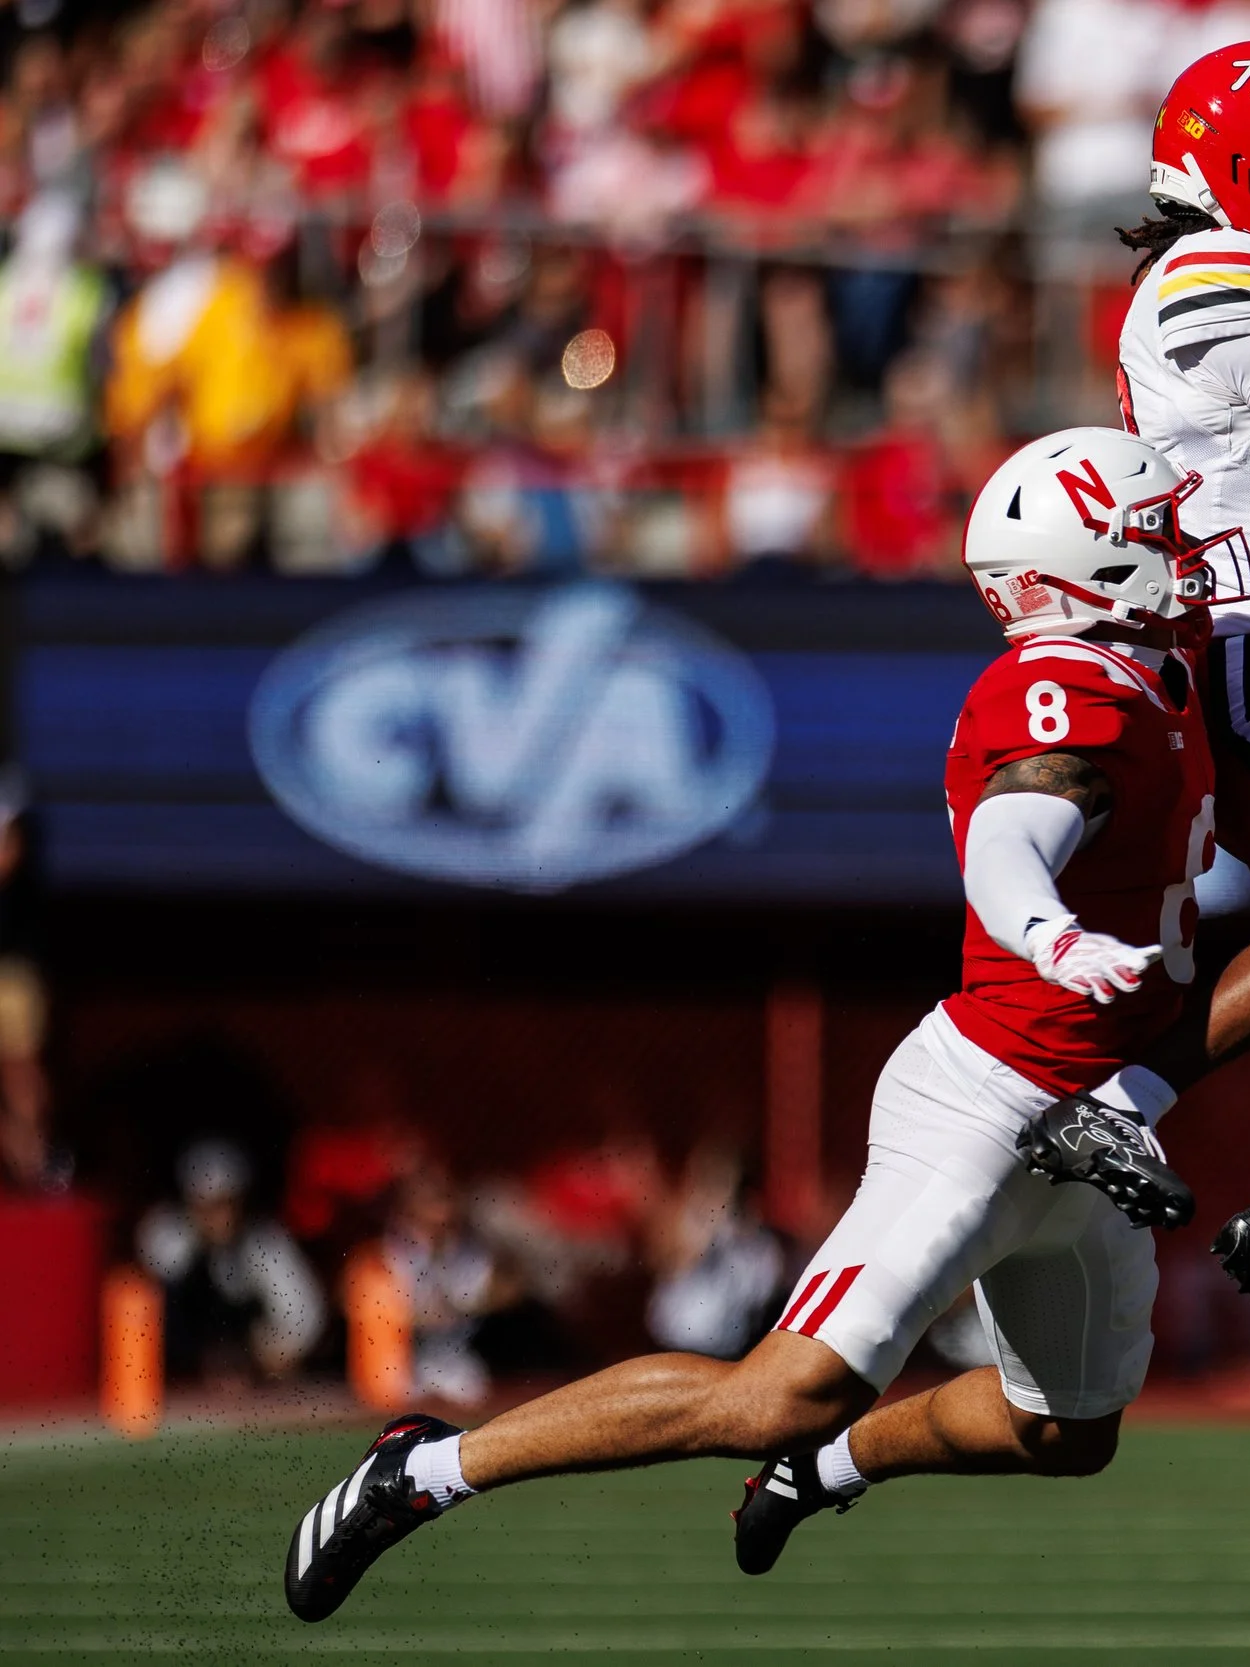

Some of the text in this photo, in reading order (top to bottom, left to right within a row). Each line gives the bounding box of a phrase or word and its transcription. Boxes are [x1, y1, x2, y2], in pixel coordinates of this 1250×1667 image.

[1056, 458, 1117, 522] N
[984, 586, 1013, 622] 8
[1025, 680, 1070, 744] 8
